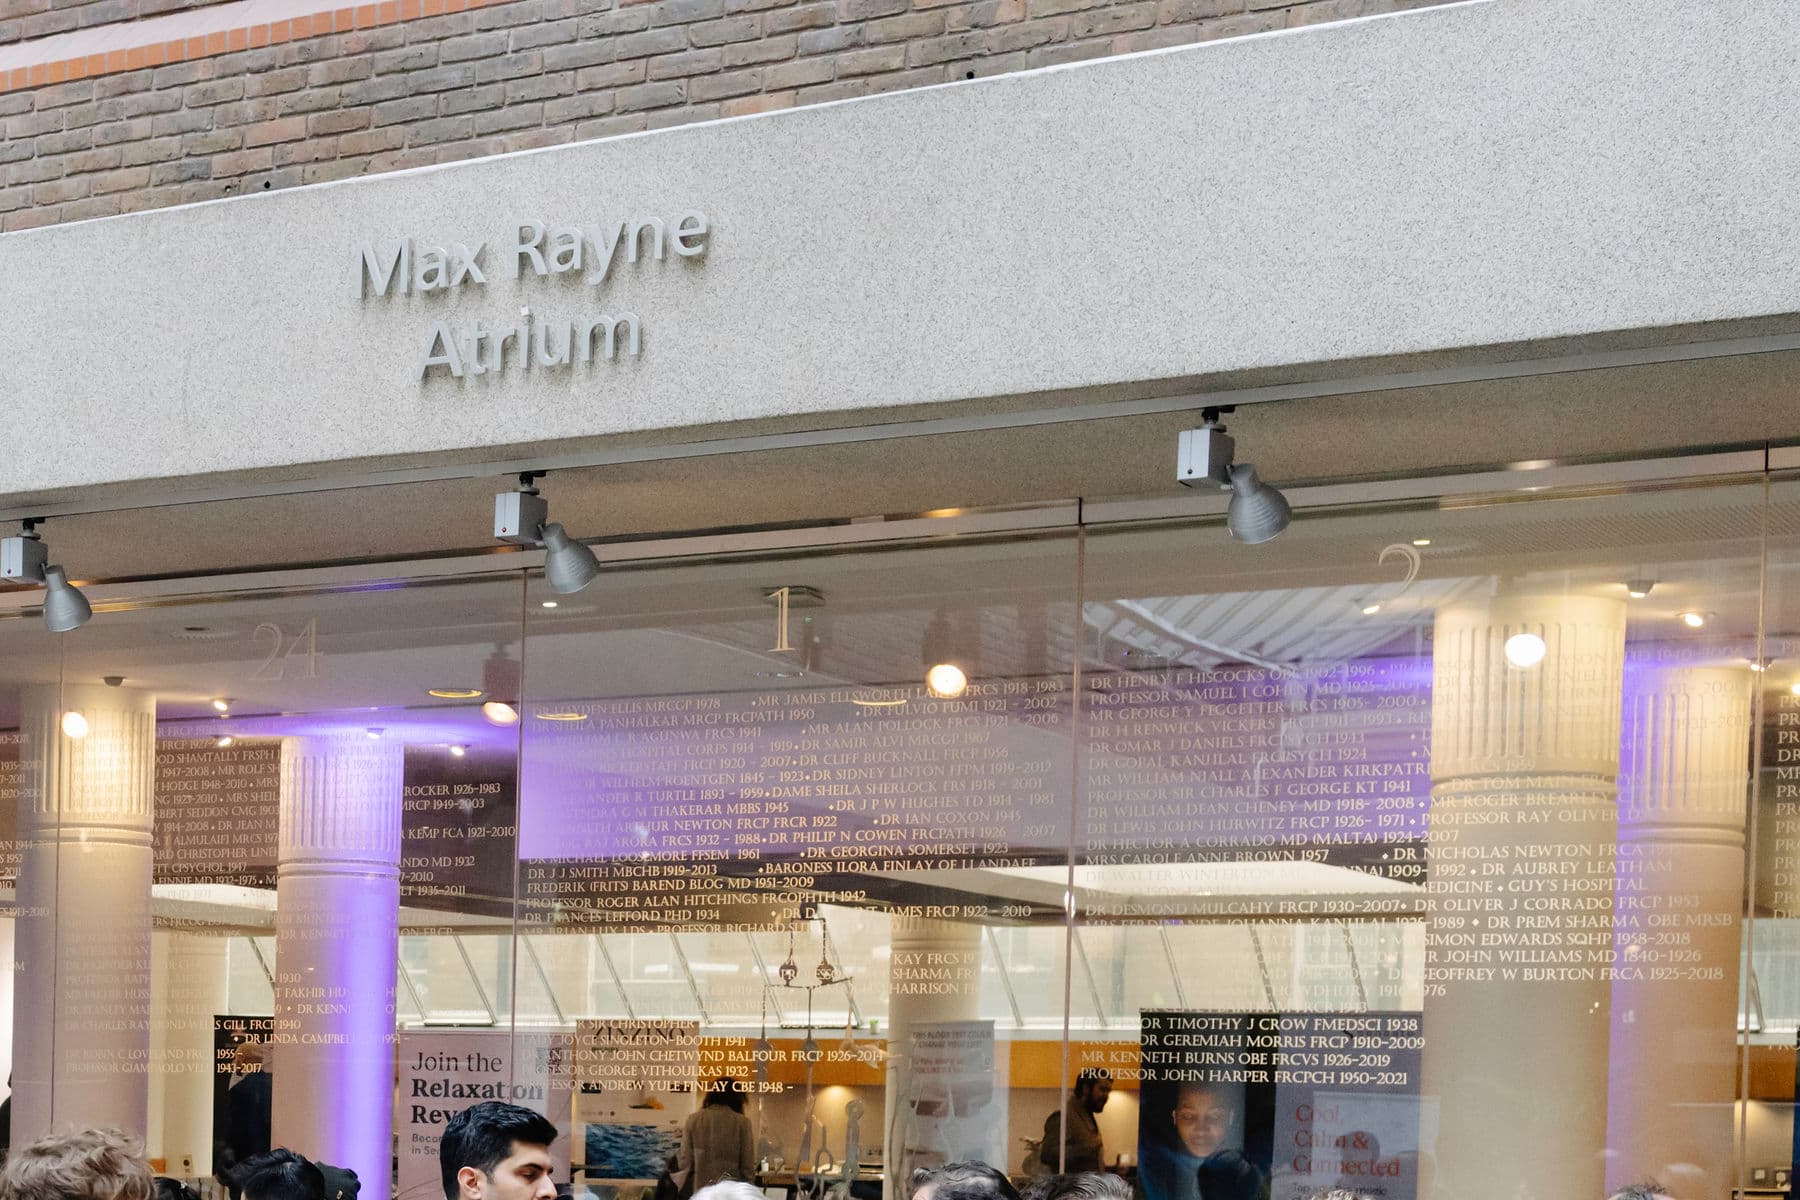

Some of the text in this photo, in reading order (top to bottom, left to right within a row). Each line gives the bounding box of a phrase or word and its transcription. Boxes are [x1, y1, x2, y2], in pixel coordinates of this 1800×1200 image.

[353, 207, 711, 299] Max Rayne
[417, 306, 641, 382] Atrium
[1288, 781, 1410, 795] GEORGE KT 1941
[1304, 797, 1414, 811] MD 2008
[1291, 809, 1618, 829] FRCP 1971 PROFESSOR RAY OLIVER
[409, 825, 515, 839] KEMP FCA 1921-2010
[793, 829, 907, 843] PHILIP N COWEN
[1281, 830, 1458, 845] MD (MALTA) 1924-2007
[1302, 843, 1644, 861] 1957 DR NICHOLAS NEWTON FRCA
[569, 862, 832, 878] SMITH MBCHB 1919-2013 BARONESS
[1436, 860, 1672, 876] 1992 DR AUBREY LEATHAM
[633, 880, 685, 891] BAREND
[690, 879, 723, 890] BLOG
[728, 878, 751, 889] MD
[755, 877, 814, 888] 1951-2009
[1509, 878, 1649, 892] GUY'S HOSPITAL
[597, 894, 758, 908] ROGER ALAN HITCHINGS
[1193, 896, 1661, 914] MULCAHY FRCP 1930-2007 DR OLIVER J CORRADO FRCP
[665, 910, 691, 921] PHD
[696, 910, 720, 920] 1934
[1488, 913, 1732, 929] DR PREM SHARMA OBE MRSB
[1424, 932, 1690, 946] SIMON EDWARDS SQHP 1958-2018
[1444, 949, 1701, 963] JOHN WILLIAMS MD 1840-1926
[1423, 967, 1724, 981] GEOFFREY W BURTON FRCA 1925-2018
[223, 1020, 245, 1030] GILL
[1167, 1018, 1418, 1031] TIMOTHY J CROW FMEDSCI 1938
[725, 1036, 746, 1047] 1941
[1163, 1034, 1426, 1049] GEREMIAH MORRIS FRCP 1910-2009
[412, 1052, 502, 1072] Join the
[612, 1050, 883, 1062] JOHN CHETWYND BALFOUR FRCP 1926-2014
[1081, 1051, 1391, 1067] MR KENNETH BURNS OBE FRCVS 1926-2019
[589, 1065, 749, 1077] GEORGE VITHOULKAS 1932
[1080, 1068, 1408, 1085] PROFESSOR JOHN HARPER FRCPCH 1950-2021
[412, 1078, 544, 1100] Relaxaton
[591, 1080, 783, 1093] ANDREW YULE FINLAY CBE 1948
[1352, 1131, 1368, 1149] &
